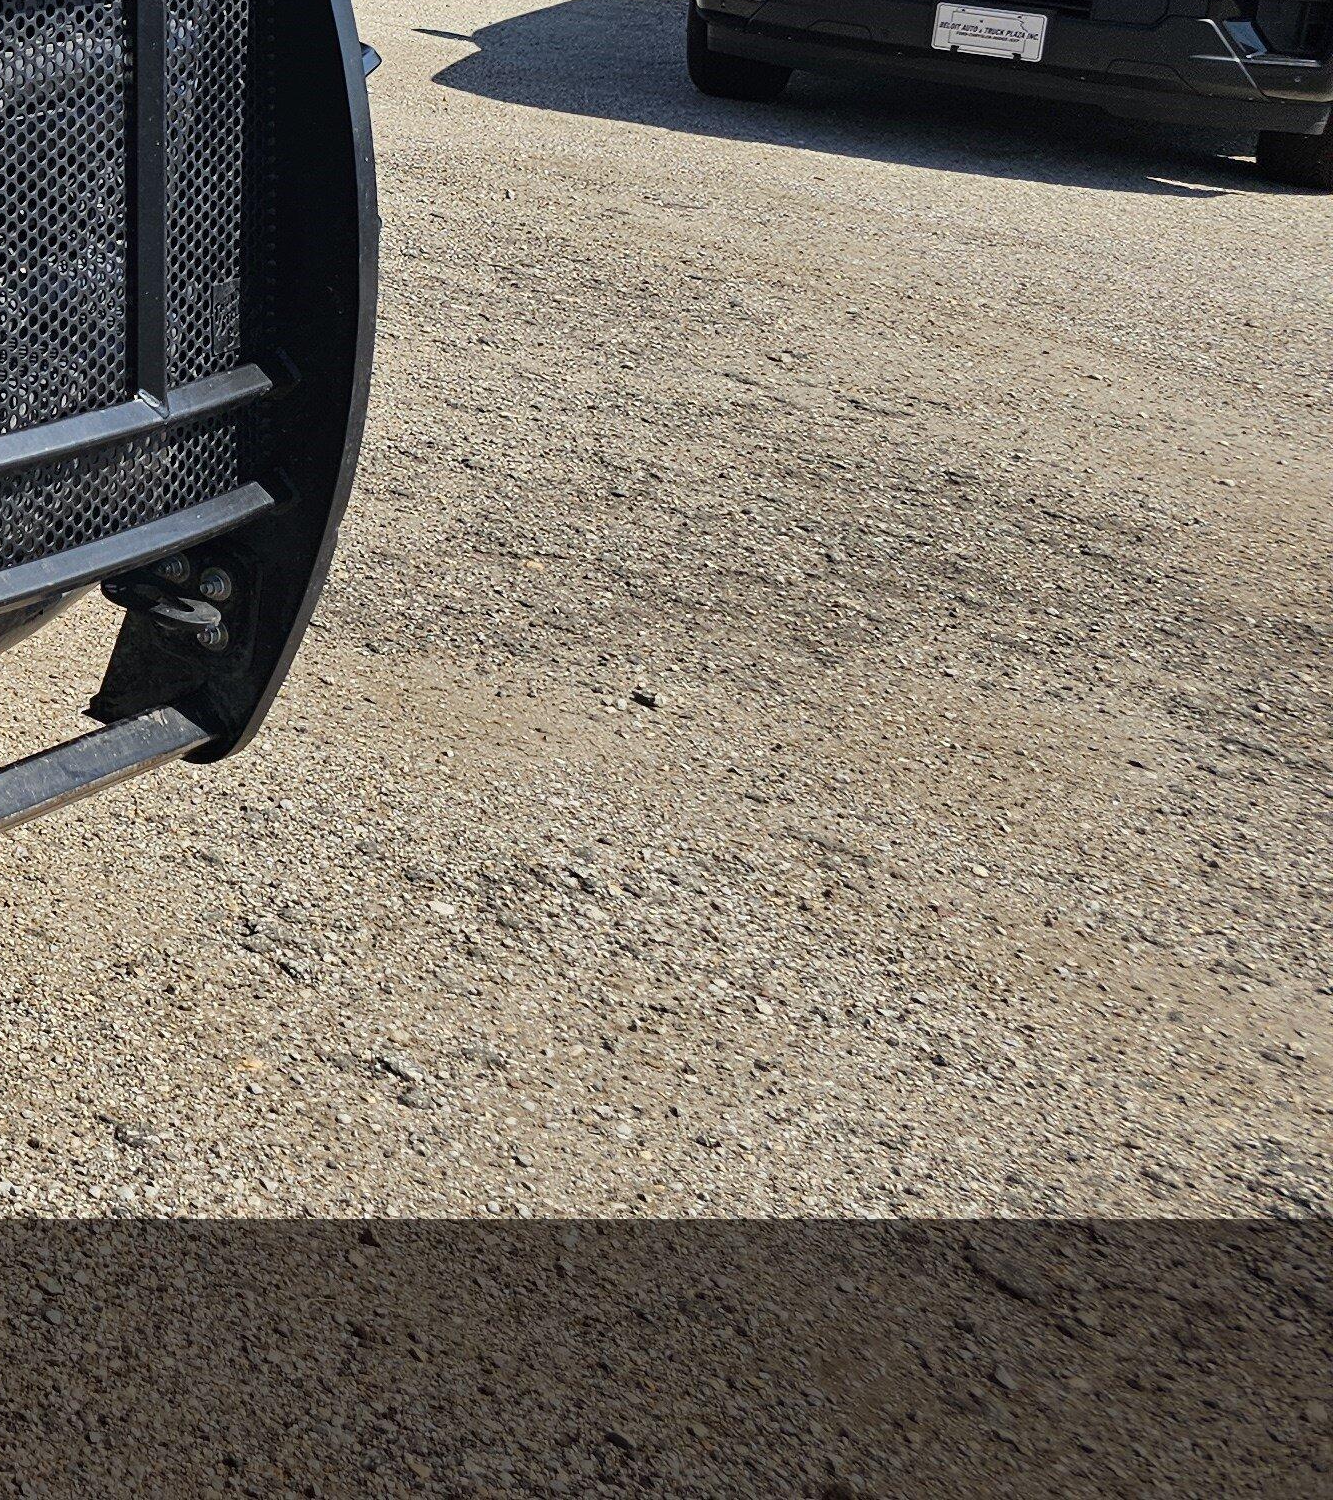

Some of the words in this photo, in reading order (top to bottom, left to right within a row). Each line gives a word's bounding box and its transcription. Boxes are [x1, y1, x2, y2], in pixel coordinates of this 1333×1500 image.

[939, 21, 961, 30] BELOIT
[962, 24, 978, 33] AUTO
[984, 27, 1004, 36] TRUCK
[1006, 30, 1025, 39] PLAZA
